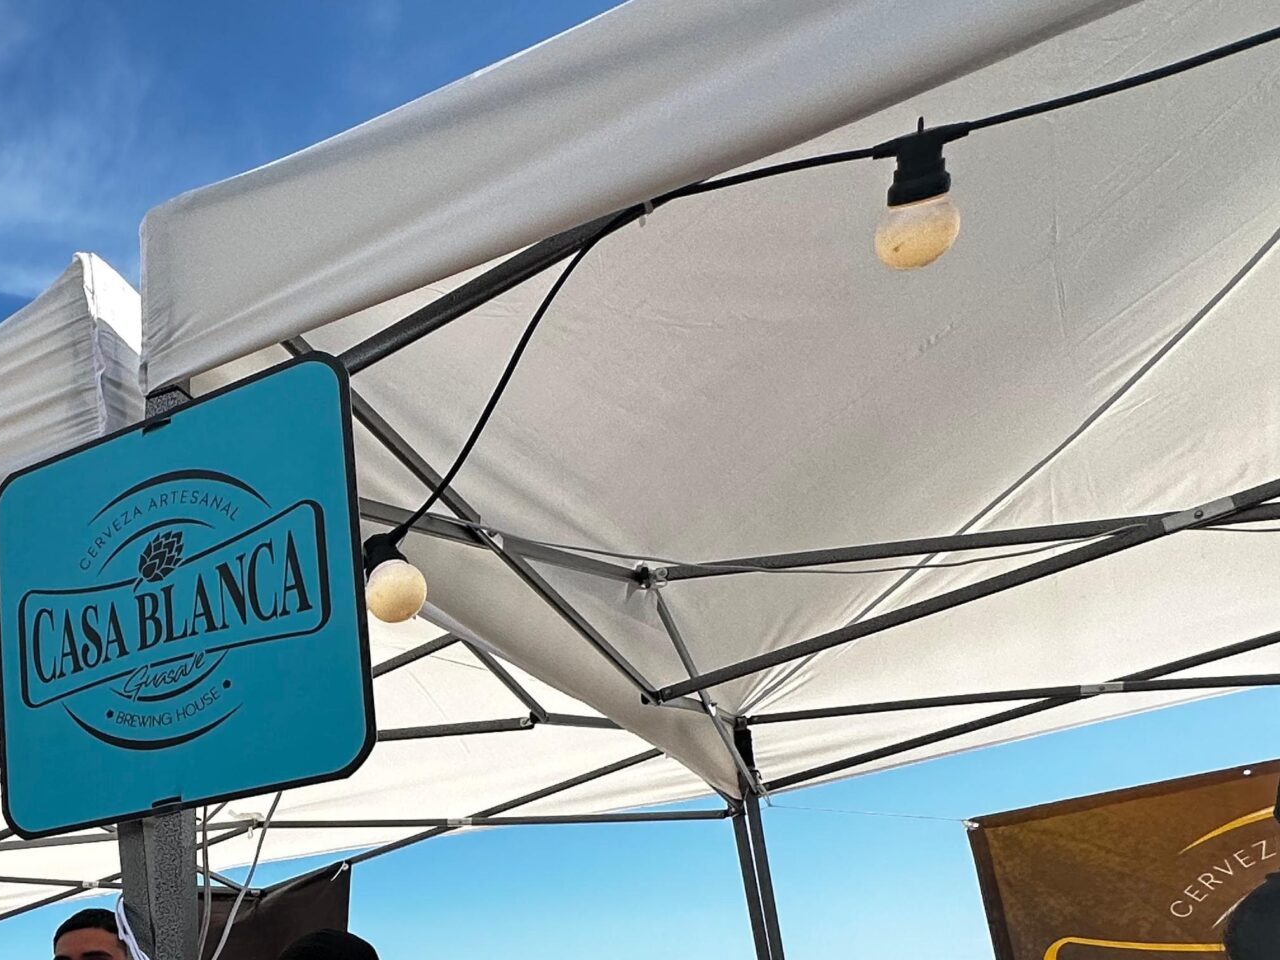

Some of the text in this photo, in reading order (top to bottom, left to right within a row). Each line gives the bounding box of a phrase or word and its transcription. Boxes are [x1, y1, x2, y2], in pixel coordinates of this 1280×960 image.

[80, 490, 240, 571] CERVEZA ARTESANAL
[32, 529, 313, 684] CASA BLANCA
[115, 687, 221, 728] BREWING HOUSE
[123, 651, 206, 702] Guasave
[1170, 840, 1277, 918] CERVEZ
